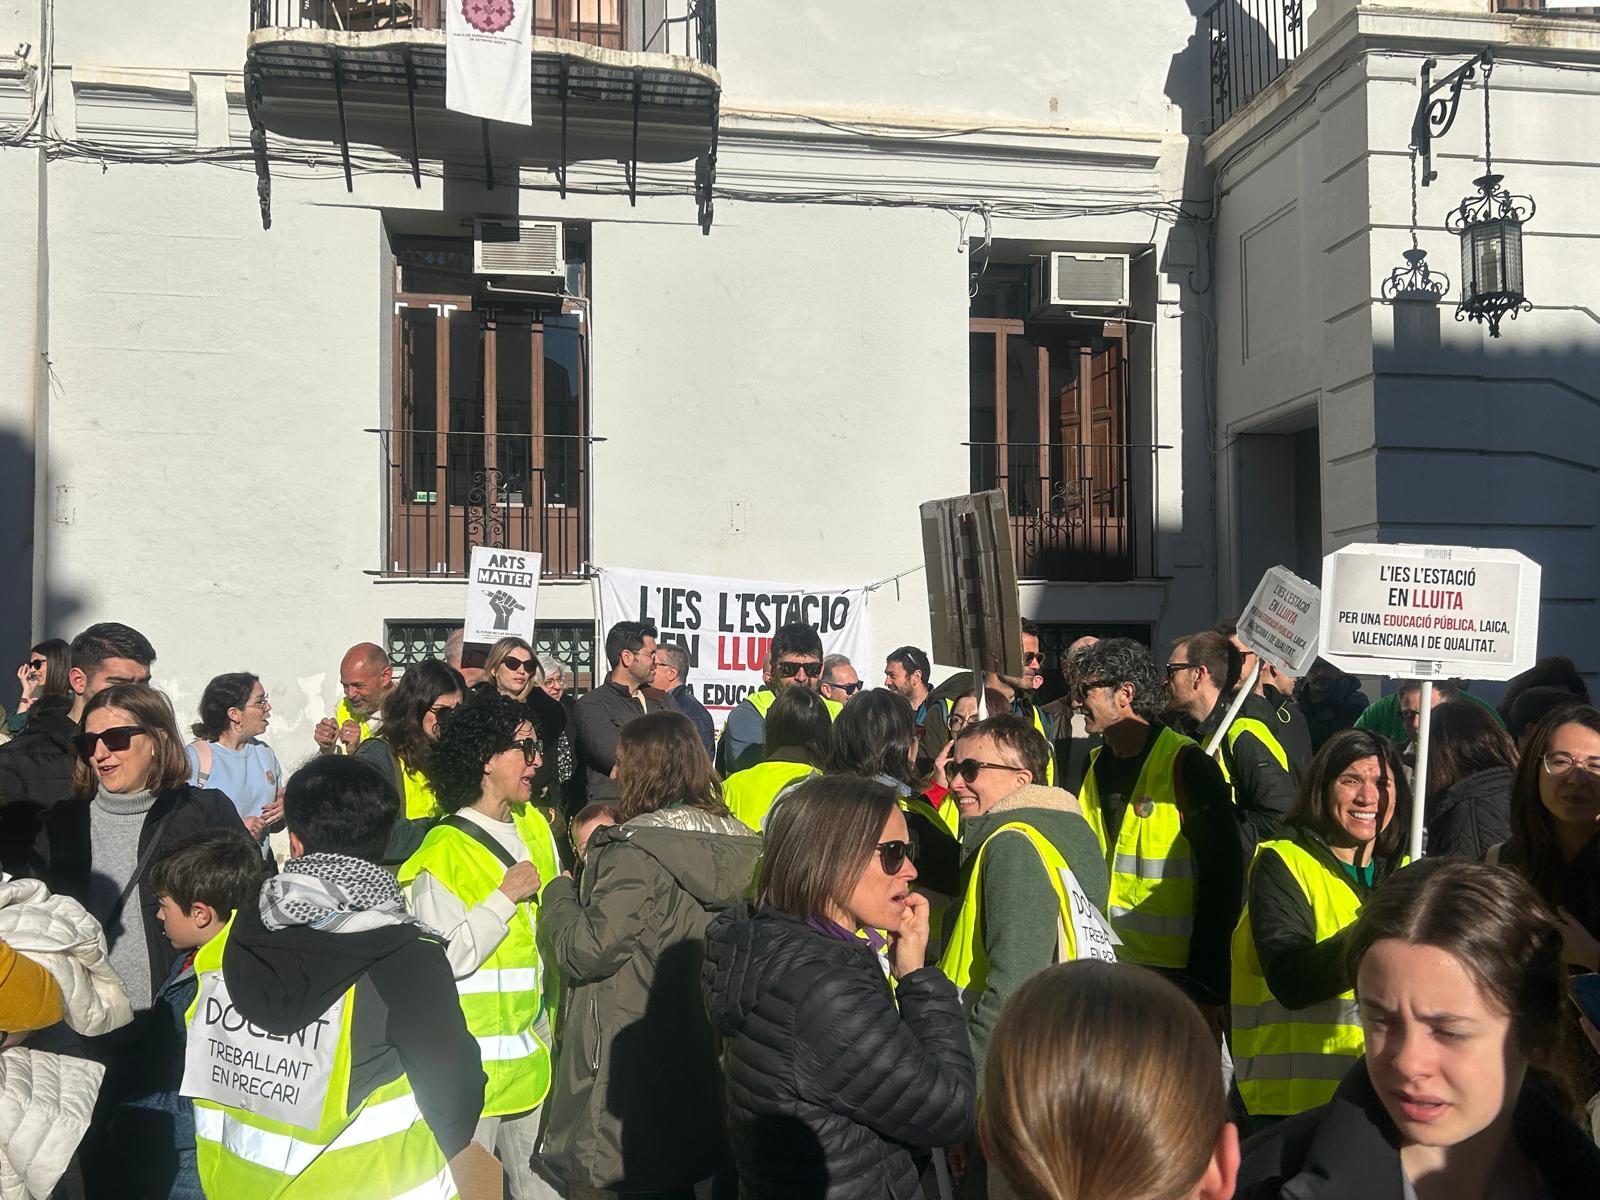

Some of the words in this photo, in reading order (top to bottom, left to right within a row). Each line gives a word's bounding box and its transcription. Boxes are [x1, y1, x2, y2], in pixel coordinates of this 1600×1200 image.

[488, 554, 525, 569] ARTS
[478, 569, 531, 586] MATTER
[1380, 565, 1410, 583] L'IES
[1413, 567, 1476, 587] L'ESTACIÓ
[639, 585, 702, 630] L'IES
[1388, 588, 1409, 607] EN
[1412, 589, 1464, 610] LLUITA
[1339, 611, 1359, 625] PER
[1361, 612, 1381, 626] UNA
[1383, 613, 1432, 629] EDUCACIÓ
[1434, 616, 1477, 633] PÚBLICA,
[1479, 619, 1511, 635] LAICA,
[660, 632, 700, 668] N
[717, 635, 773, 671] LLU
[1352, 631, 1418, 648] VALENCIANA
[1421, 635, 1425, 649] I
[1427, 636, 1440, 650] DE
[1443, 637, 1497, 653] QUALITAT.
[208, 1038, 313, 1081] TREBALLANT
[211, 1065, 230, 1087] EN
[232, 1072, 300, 1105] PRECARI
